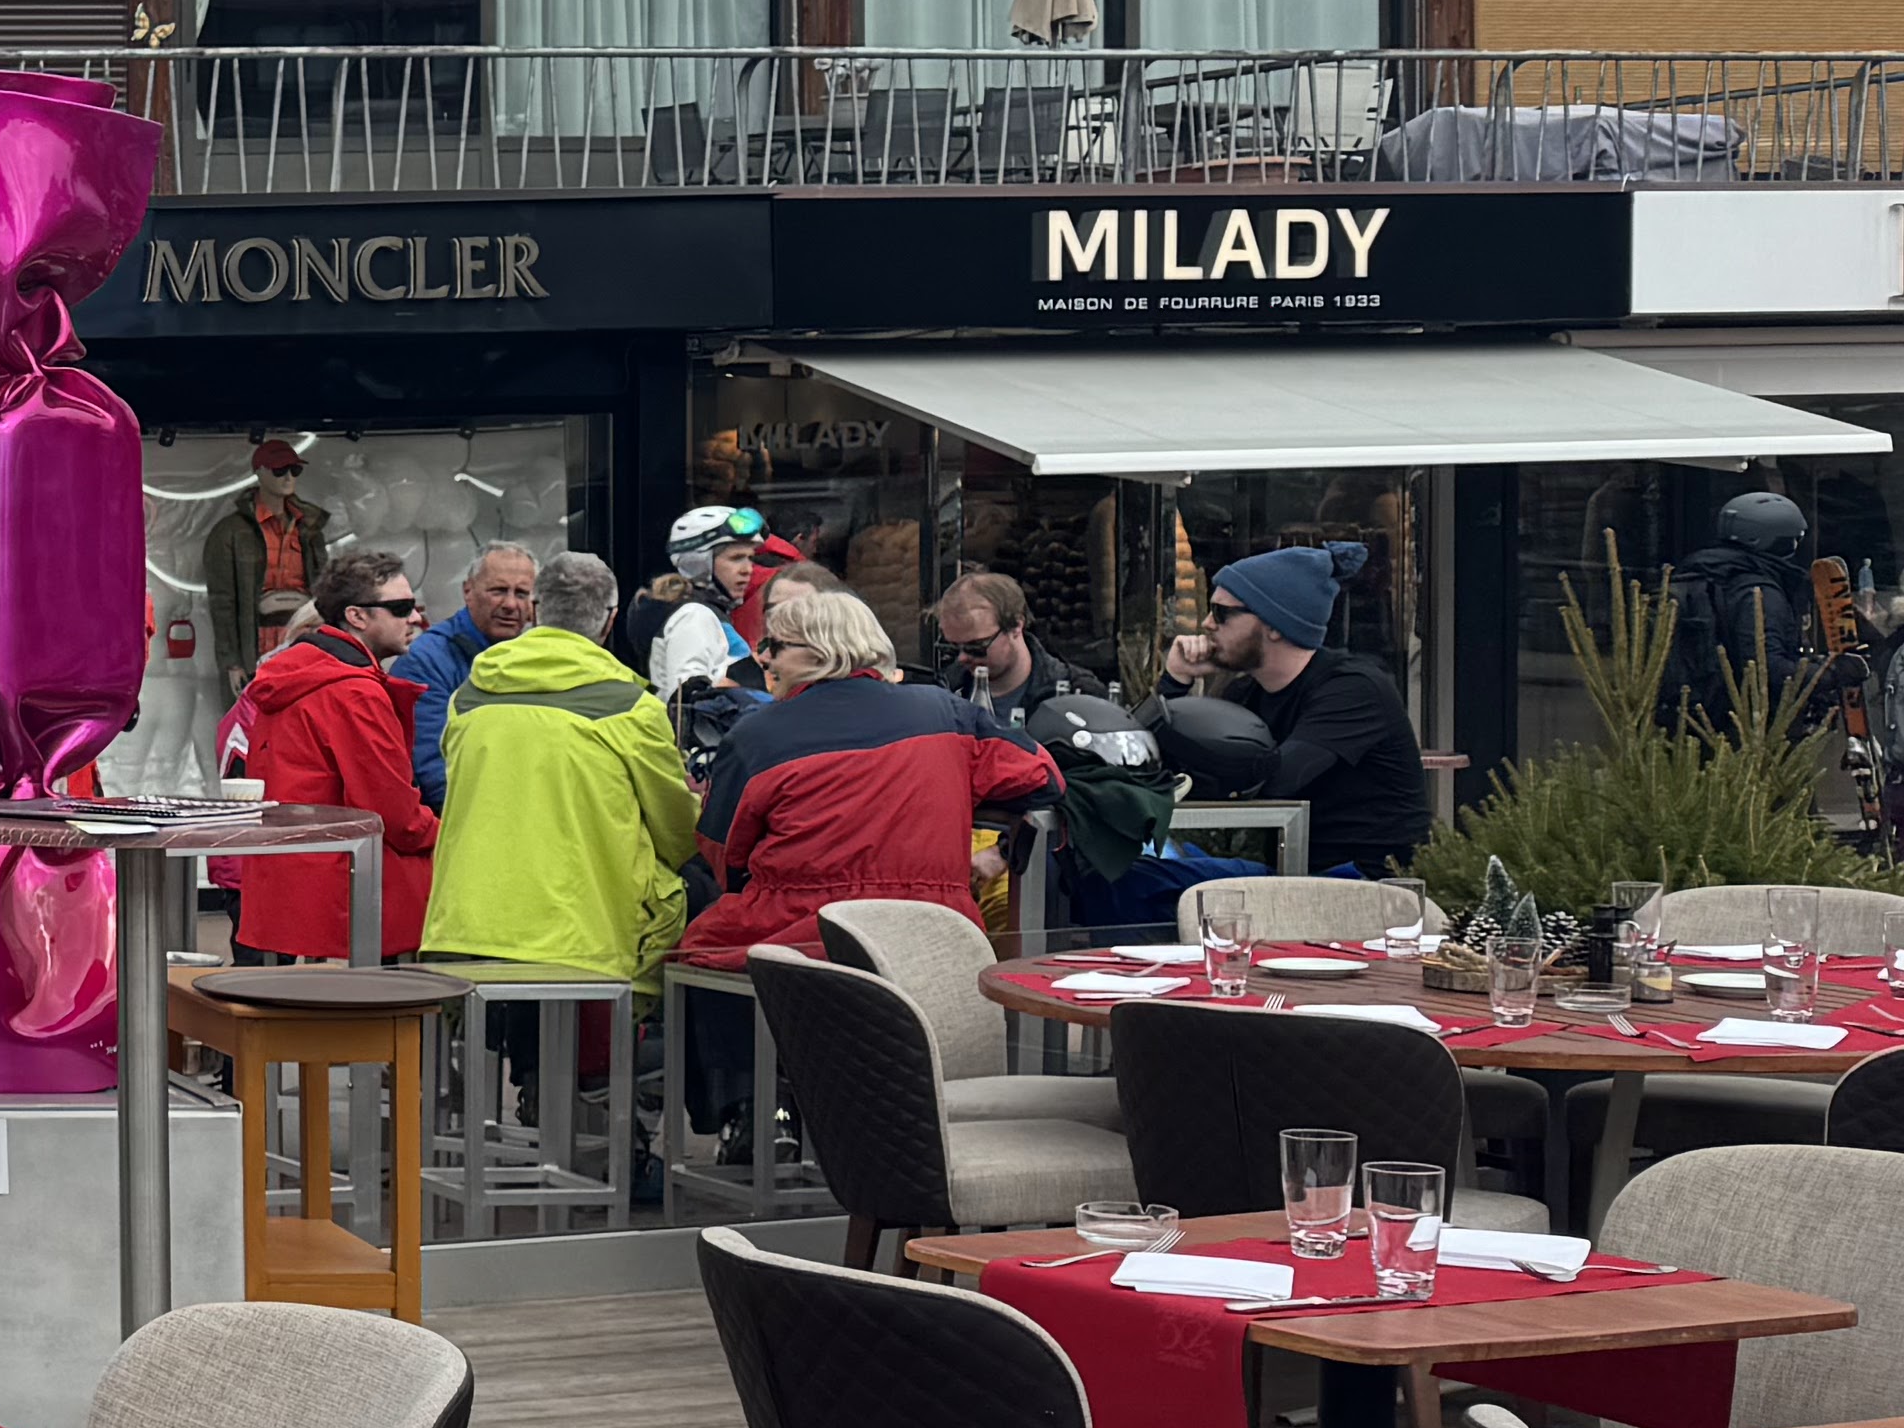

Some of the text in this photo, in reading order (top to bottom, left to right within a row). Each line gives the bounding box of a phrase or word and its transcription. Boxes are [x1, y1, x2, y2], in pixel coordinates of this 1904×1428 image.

[1046, 207, 1391, 281] MILADY
[143, 234, 550, 304] MONCLER
[1037, 297, 1113, 311] MAISON
[1124, 297, 1149, 310] DE
[1270, 295, 1325, 308] PARIS
[1333, 294, 1382, 308] 1933
[737, 421, 891, 450] MILADY
